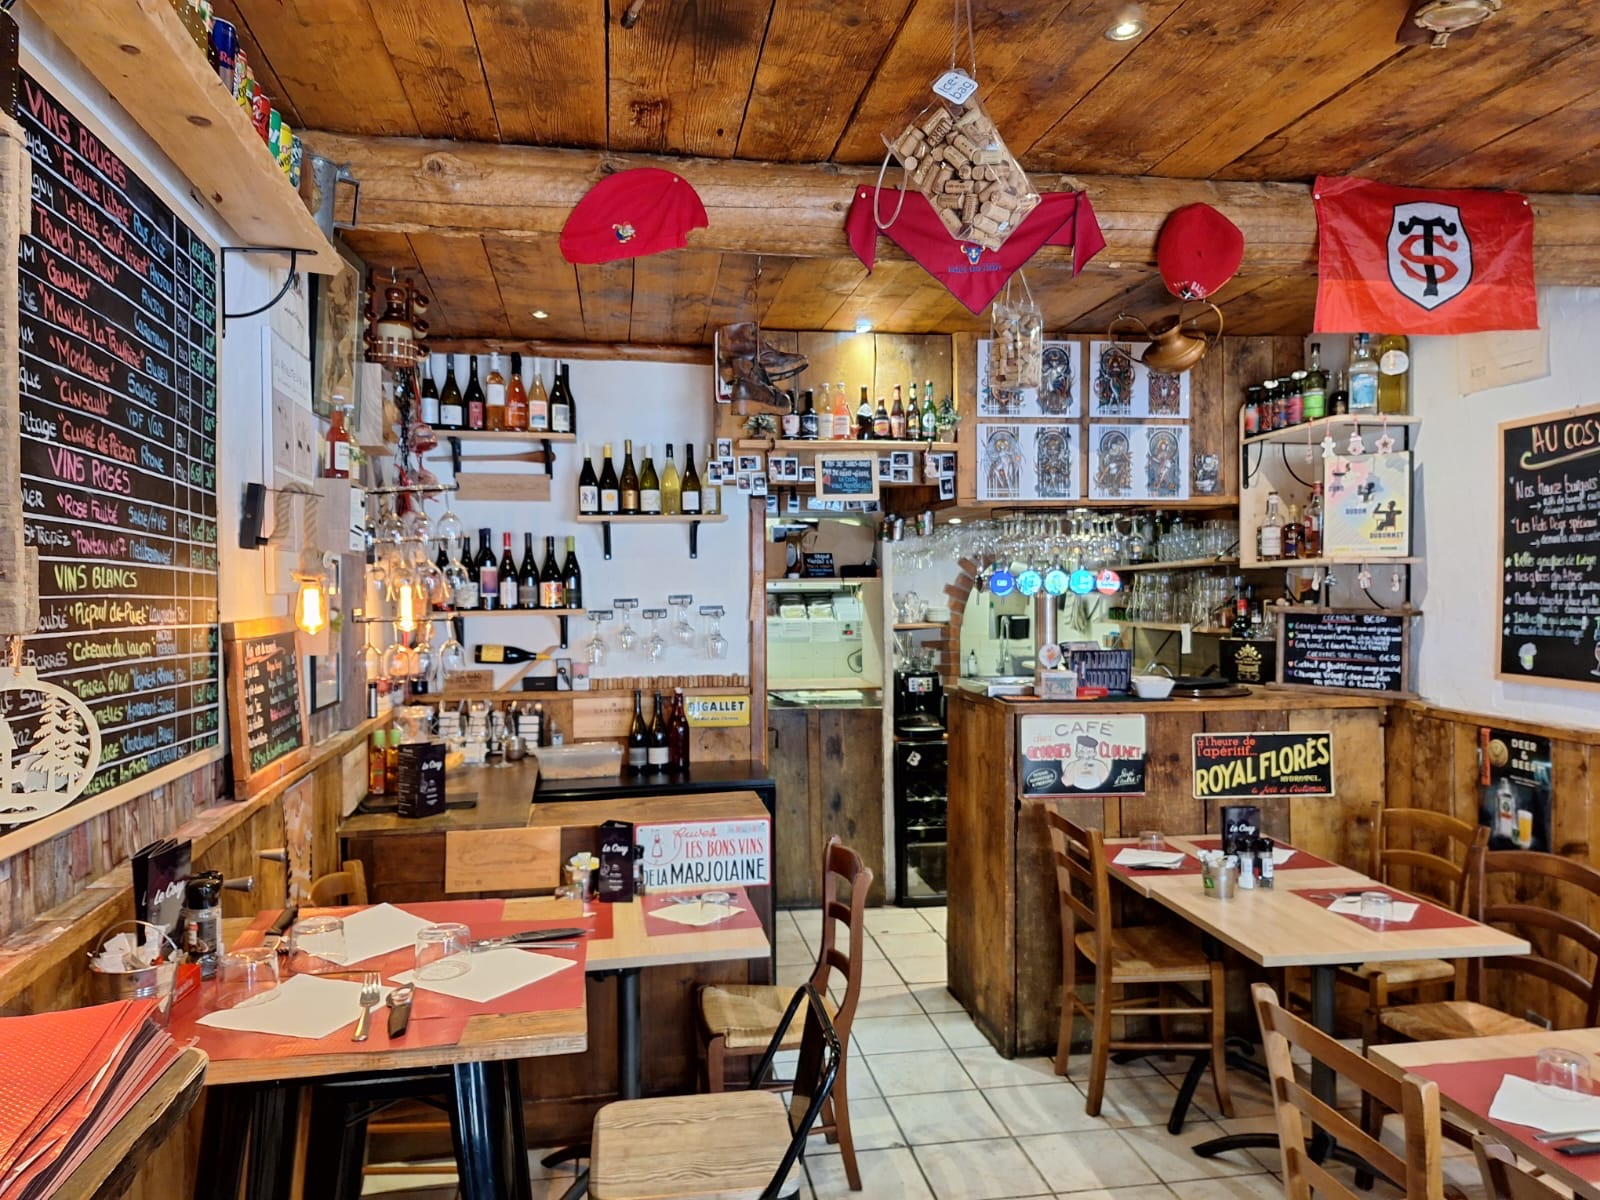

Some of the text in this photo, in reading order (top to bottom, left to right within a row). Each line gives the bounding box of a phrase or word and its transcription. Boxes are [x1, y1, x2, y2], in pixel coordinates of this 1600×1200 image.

[25, 80, 127, 190] VINS ROUGES
[19, 366, 42, 396] que
[1531, 424, 1559, 454] AU
[48, 446, 132, 495] VINS ROSES
[1516, 479, 1536, 501] Nos
[54, 564, 139, 593] VINS BLANCS
[1055, 720, 1114, 737] CAFÉ
[1205, 736, 1239, 747] l'heure
[1243, 735, 1257, 746] de
[1511, 758, 1537, 773] BEER
[1520, 750, 1529, 761] &
[1196, 757, 1257, 796] ROYAL
[685, 836, 764, 859] LES BONS VINS
[657, 868, 668, 886] LA
[670, 857, 767, 885] MARJOLAINE
